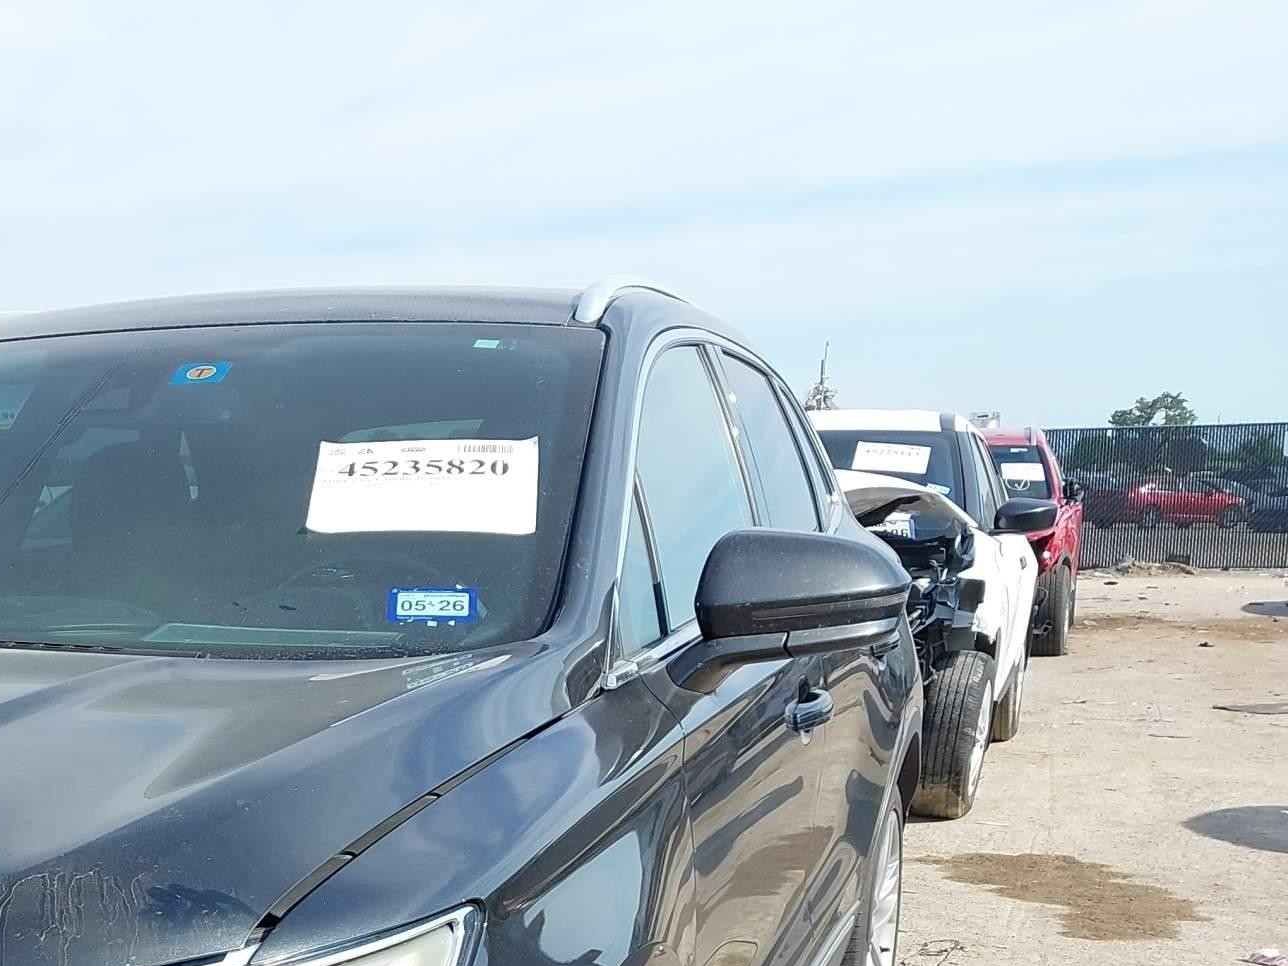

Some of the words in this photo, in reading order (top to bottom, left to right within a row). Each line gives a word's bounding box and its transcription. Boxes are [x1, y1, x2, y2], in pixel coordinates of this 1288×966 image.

[338, 458, 510, 478] 45235820
[400, 599, 427, 612] 05
[438, 599, 465, 612] 26
